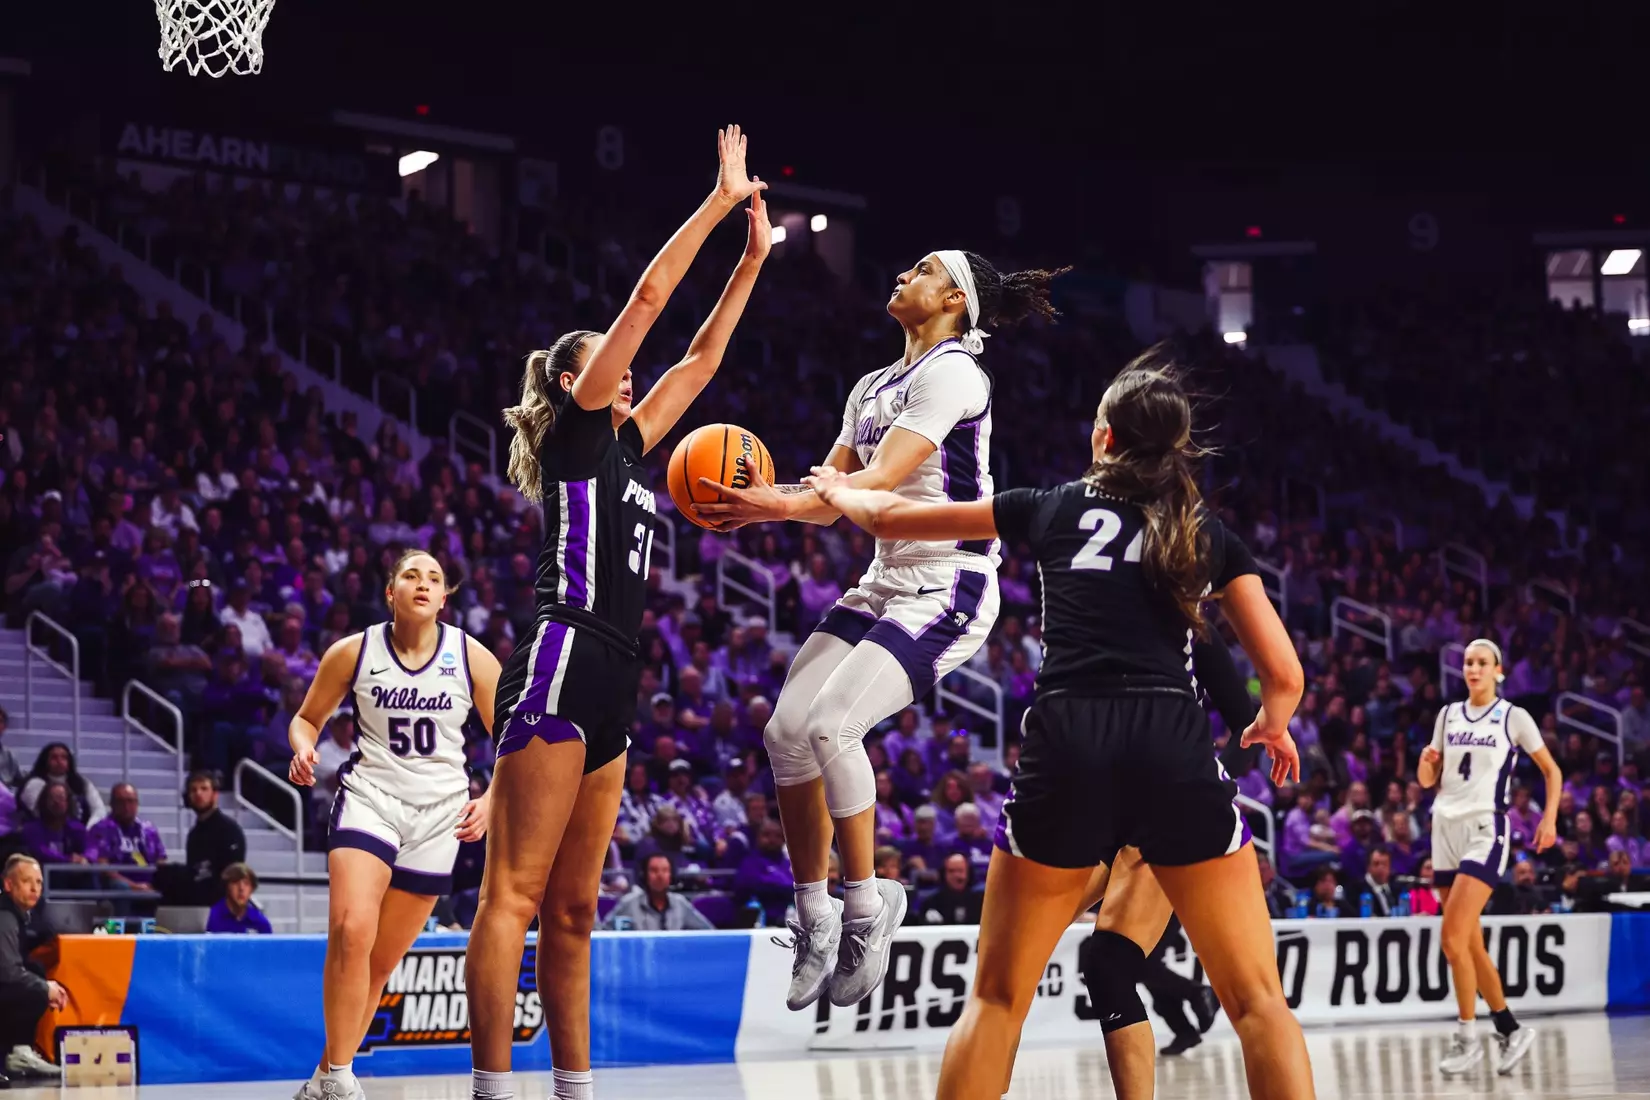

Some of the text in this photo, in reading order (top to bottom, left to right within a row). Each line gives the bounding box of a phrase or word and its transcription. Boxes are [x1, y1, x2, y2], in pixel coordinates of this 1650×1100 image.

[117, 121, 270, 171] AHEARN
[597, 124, 624, 171] 8
[1408, 212, 1439, 250] 9
[371, 686, 453, 710] Wildcats
[388, 716, 437, 757] 50
[1447, 732, 1497, 748] Wildcats
[1458, 751, 1472, 781] 4
[1331, 924, 1565, 1005] ROUDS
[401, 992, 543, 1031] MADSS
